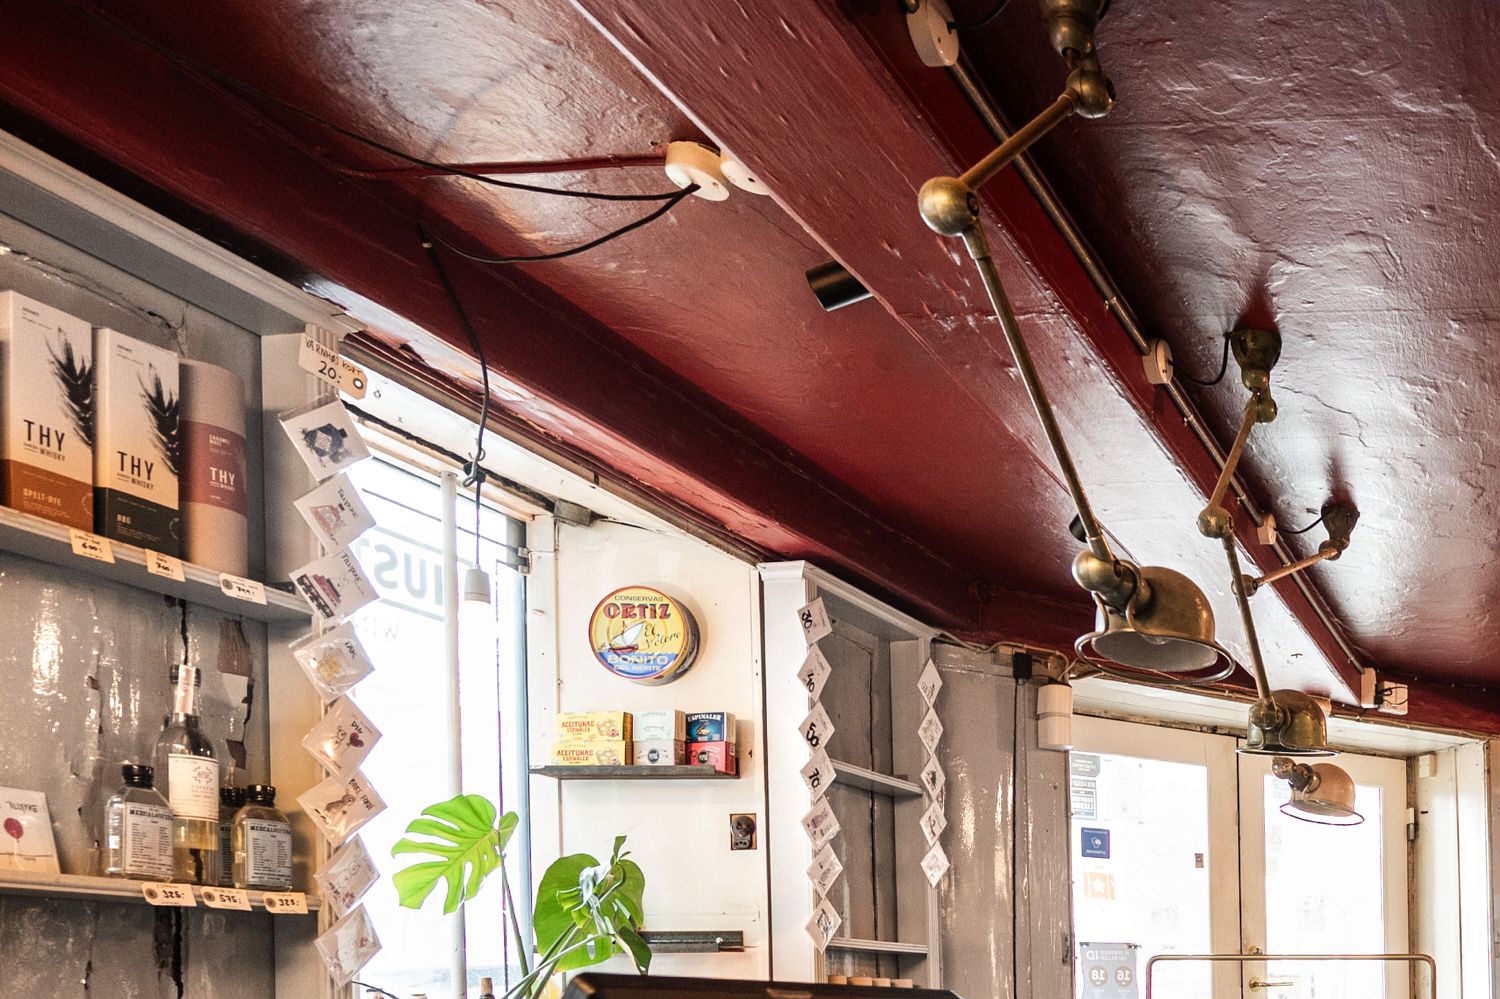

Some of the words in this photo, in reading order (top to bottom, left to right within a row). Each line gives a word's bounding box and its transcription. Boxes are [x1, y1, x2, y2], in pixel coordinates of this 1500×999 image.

[23, 419, 65, 452] THY
[40, 448, 66, 462] WHISKY
[117, 450, 154, 481] THY
[210, 467, 235, 486] THY
[131, 478, 154, 491] WHISKY
[603, 602, 671, 620] ORTIZ
[607, 654, 668, 665] BONITO
[561, 720, 595, 728] ACEITUNAS
[556, 749, 594, 757] ACEITUNAS
